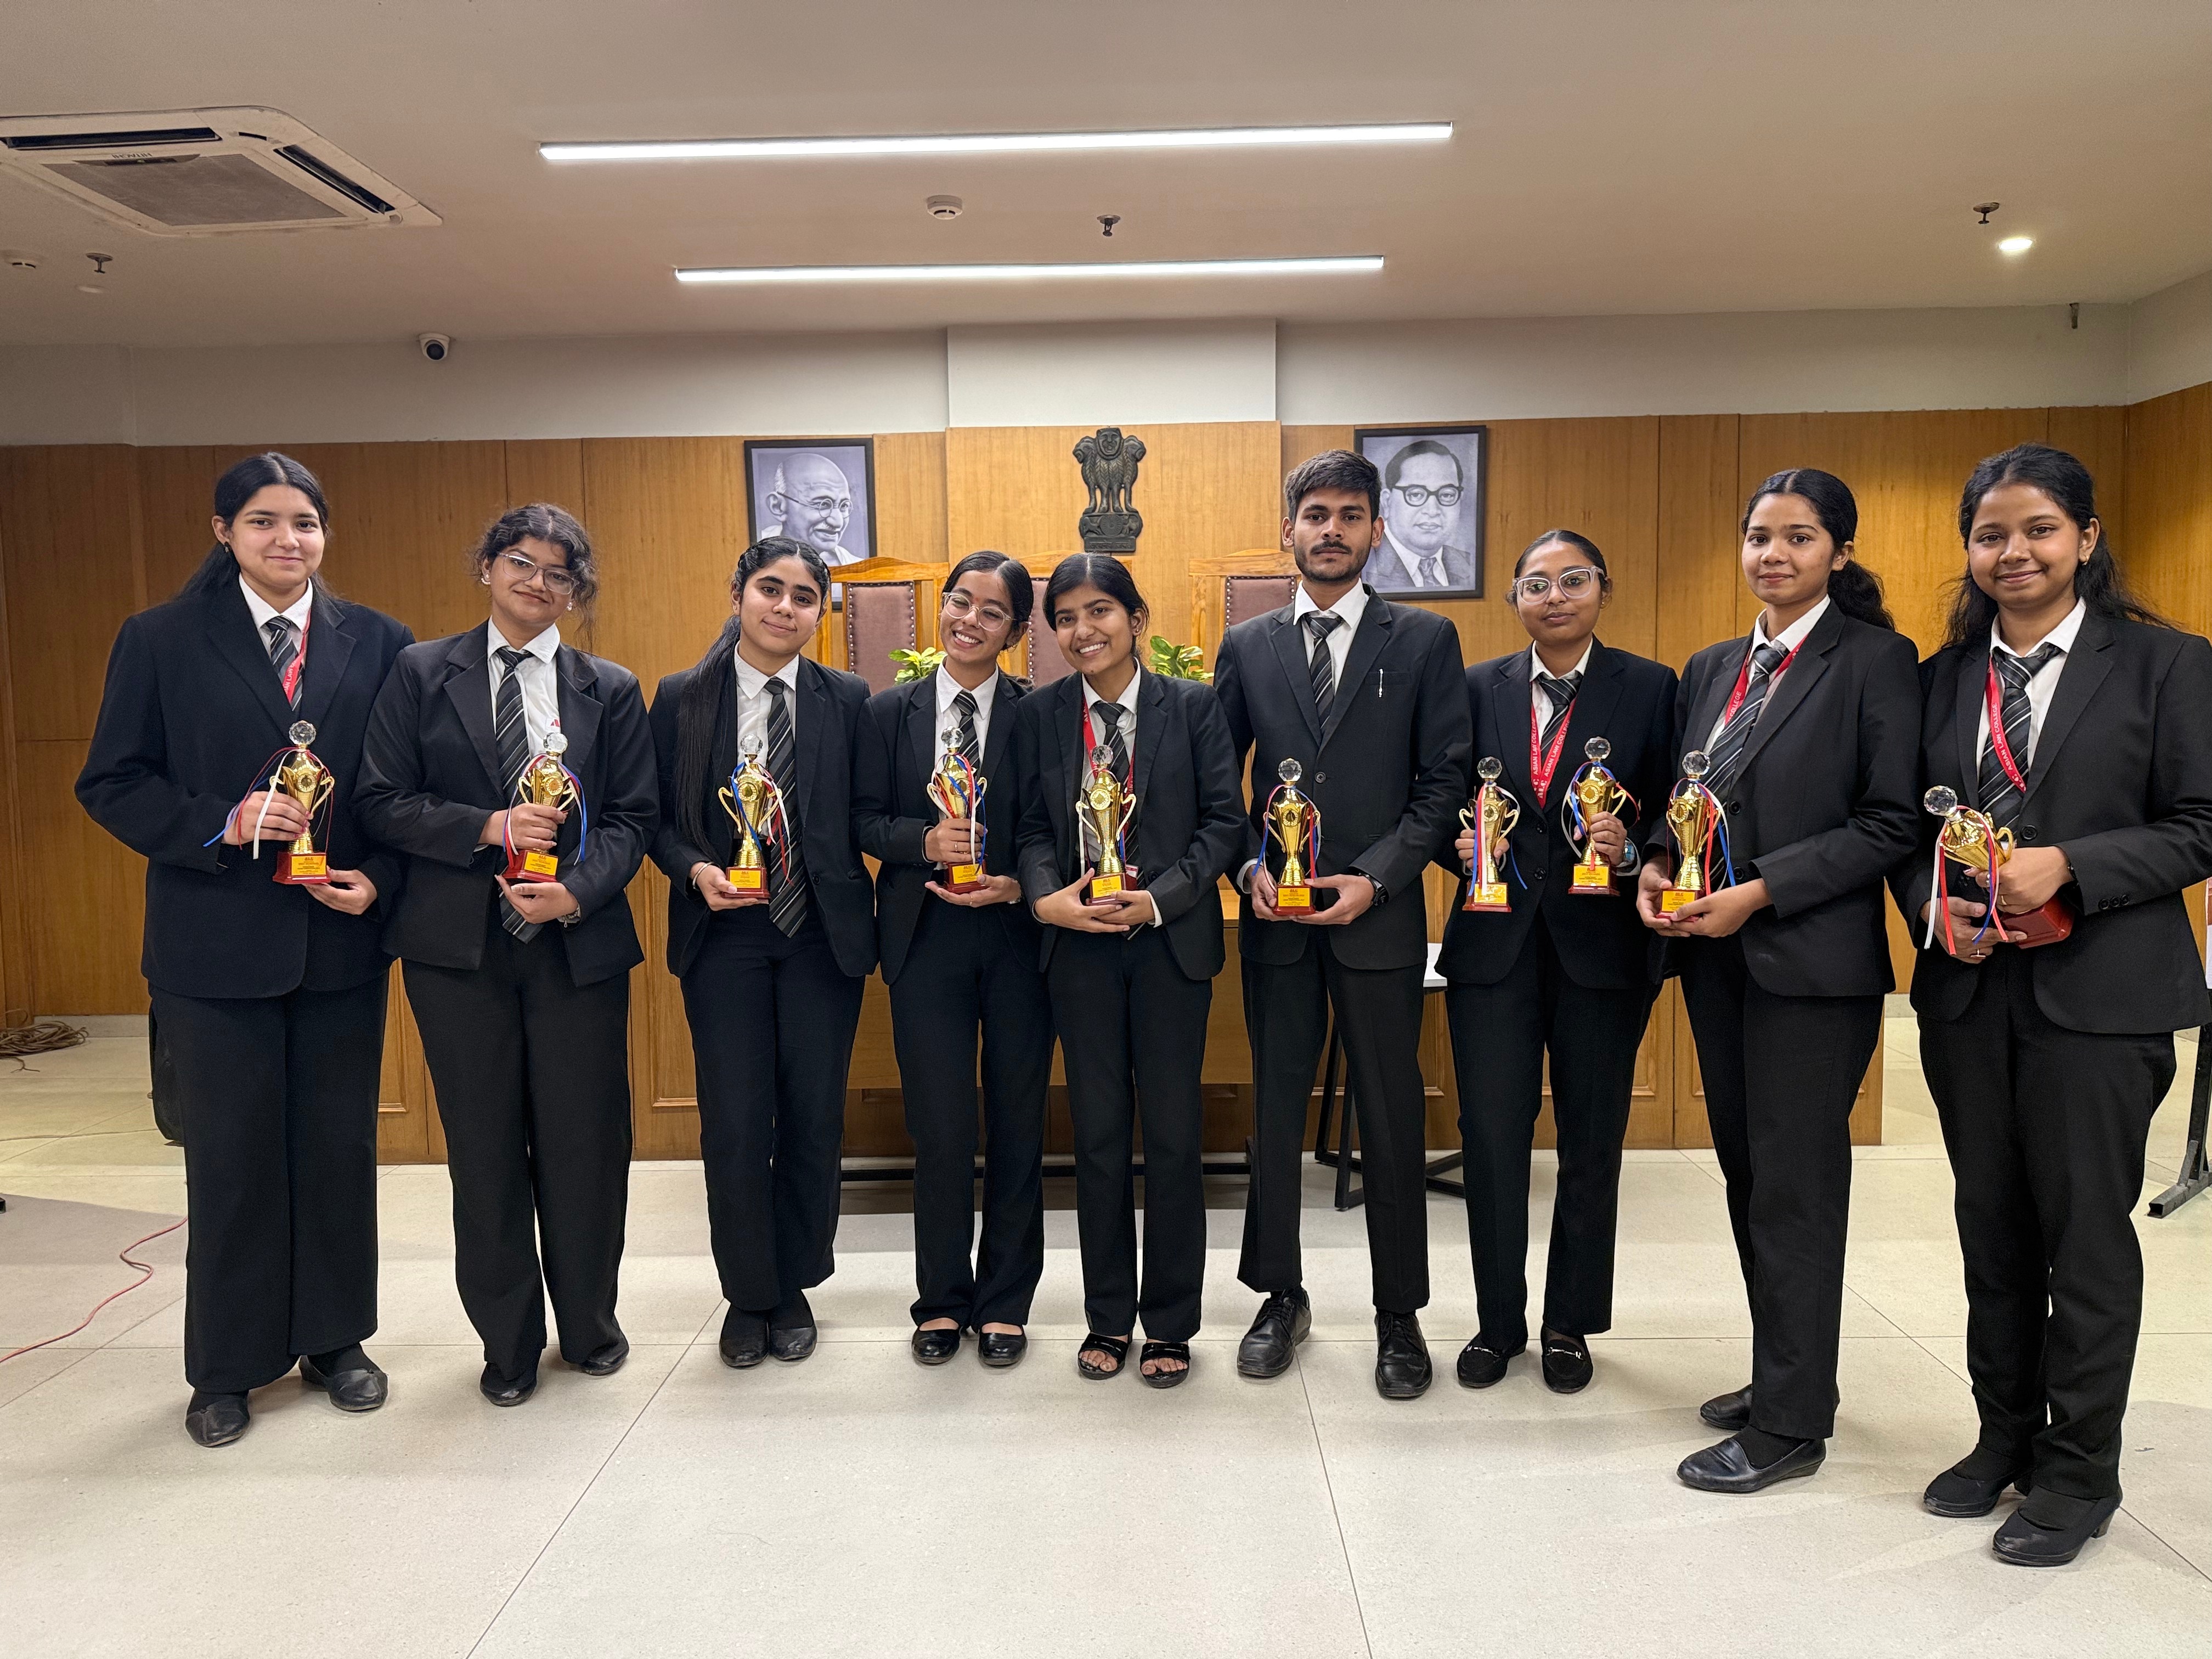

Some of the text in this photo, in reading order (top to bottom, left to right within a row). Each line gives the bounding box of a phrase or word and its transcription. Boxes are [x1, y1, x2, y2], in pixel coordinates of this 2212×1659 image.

[1730, 691, 1742, 717] COLLEGE
[1992, 702, 2000, 733] COLLEGE
[1544, 758, 1555, 777] ASIAN
[1551, 744, 1560, 758] LAW
[2001, 749, 2013, 771] ASIAN
